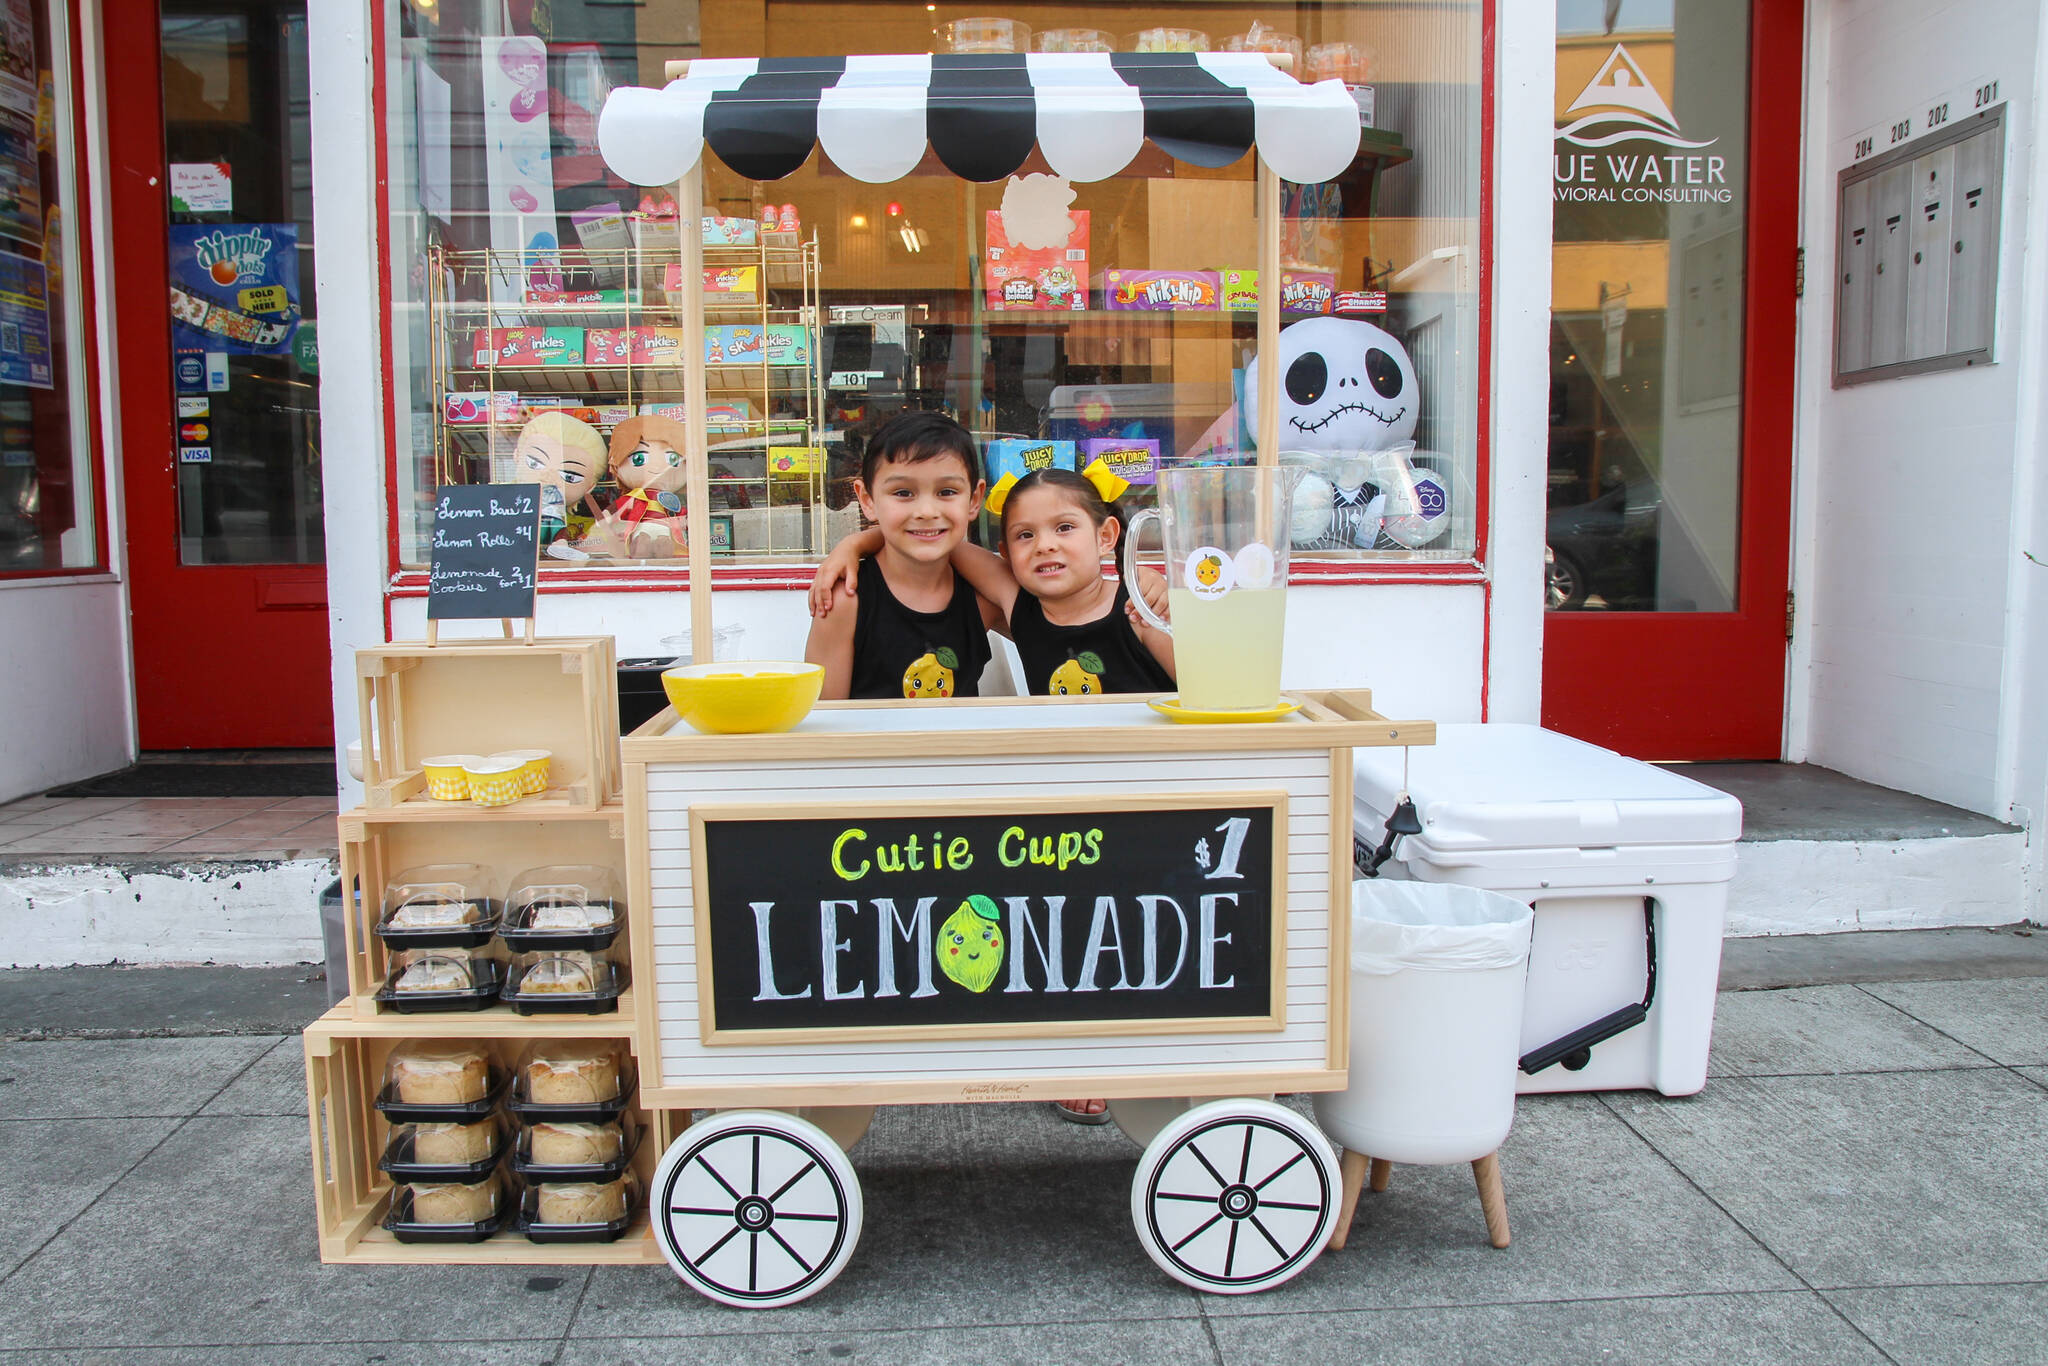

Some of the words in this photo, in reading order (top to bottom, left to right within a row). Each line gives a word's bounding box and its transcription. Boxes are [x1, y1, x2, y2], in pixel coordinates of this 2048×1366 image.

[1976, 81, 1999, 109] 201
[1928, 103, 1949, 128] 202
[1891, 120, 1911, 144] 203
[1855, 137, 1873, 160] 204
[1554, 154, 1597, 183] UE
[1606, 154, 1726, 184] WATER
[1621, 188, 1732, 203] CONSULTING
[235, 258, 265, 276] dots
[249, 289, 274, 299] SOLD
[252, 301, 275, 312] HERE
[862, 306, 903, 321] Cream
[842, 374, 867, 385] 101
[184, 450, 210, 460] VISA
[1024, 446, 1054, 465] JUICY
[1030, 458, 1051, 471] DROP
[1128, 449, 1149, 462] DROP
[438, 496, 485, 519] Lemon
[434, 529, 473, 548] Lemon
[515, 526, 532, 541] $4
[431, 561, 503, 580] Lemonade
[831, 828, 974, 882] Cutie
[998, 825, 1103, 871] Cups
[1194, 817, 1252, 881] $1
